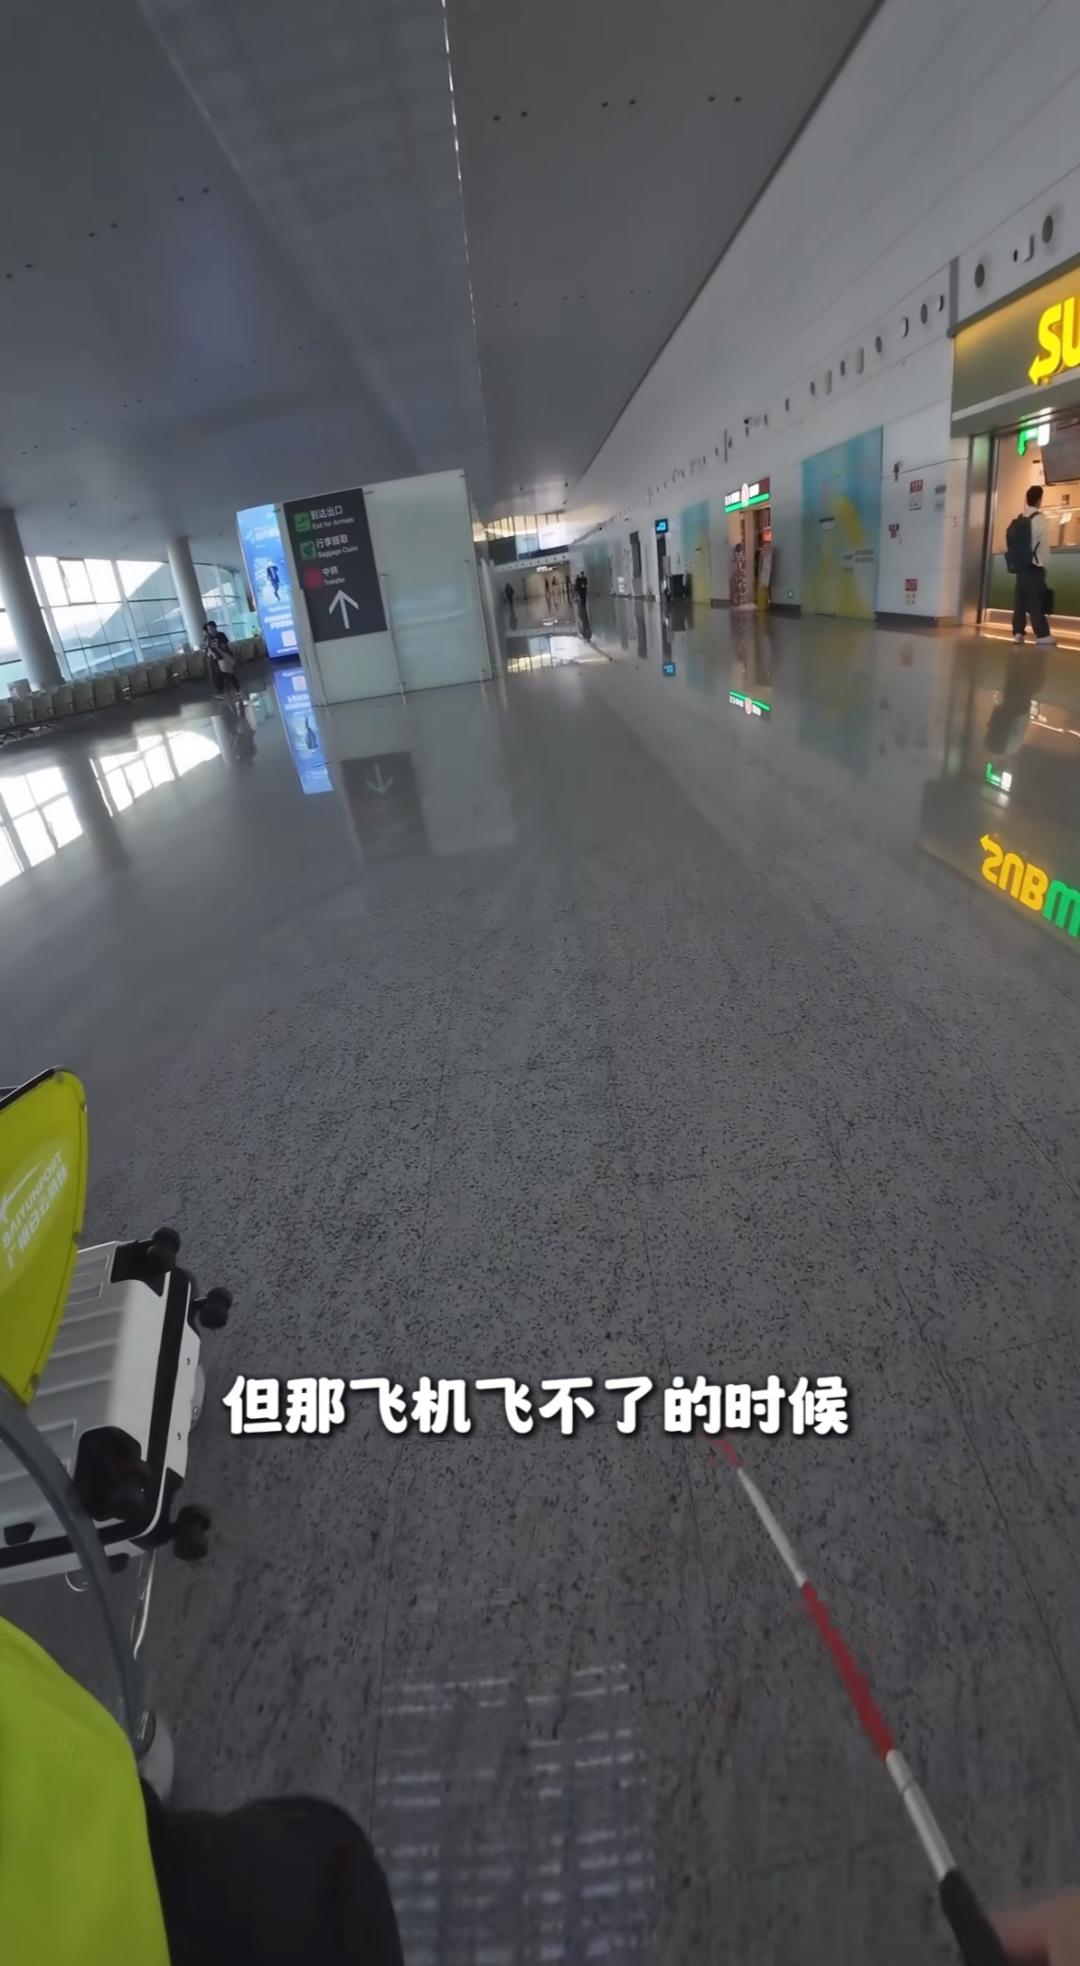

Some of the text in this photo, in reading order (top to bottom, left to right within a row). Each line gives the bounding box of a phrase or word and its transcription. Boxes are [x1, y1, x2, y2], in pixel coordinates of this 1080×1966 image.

[310, 505, 343, 520] 到达出口
[312, 522, 323, 530] Exit
[333, 517, 355, 526] Arrivals
[316, 534, 348, 549] 行李提取
[318, 549, 342, 559] Baggage
[322, 565, 338, 576] 中转
[324, 577, 345, 586] Transfer
